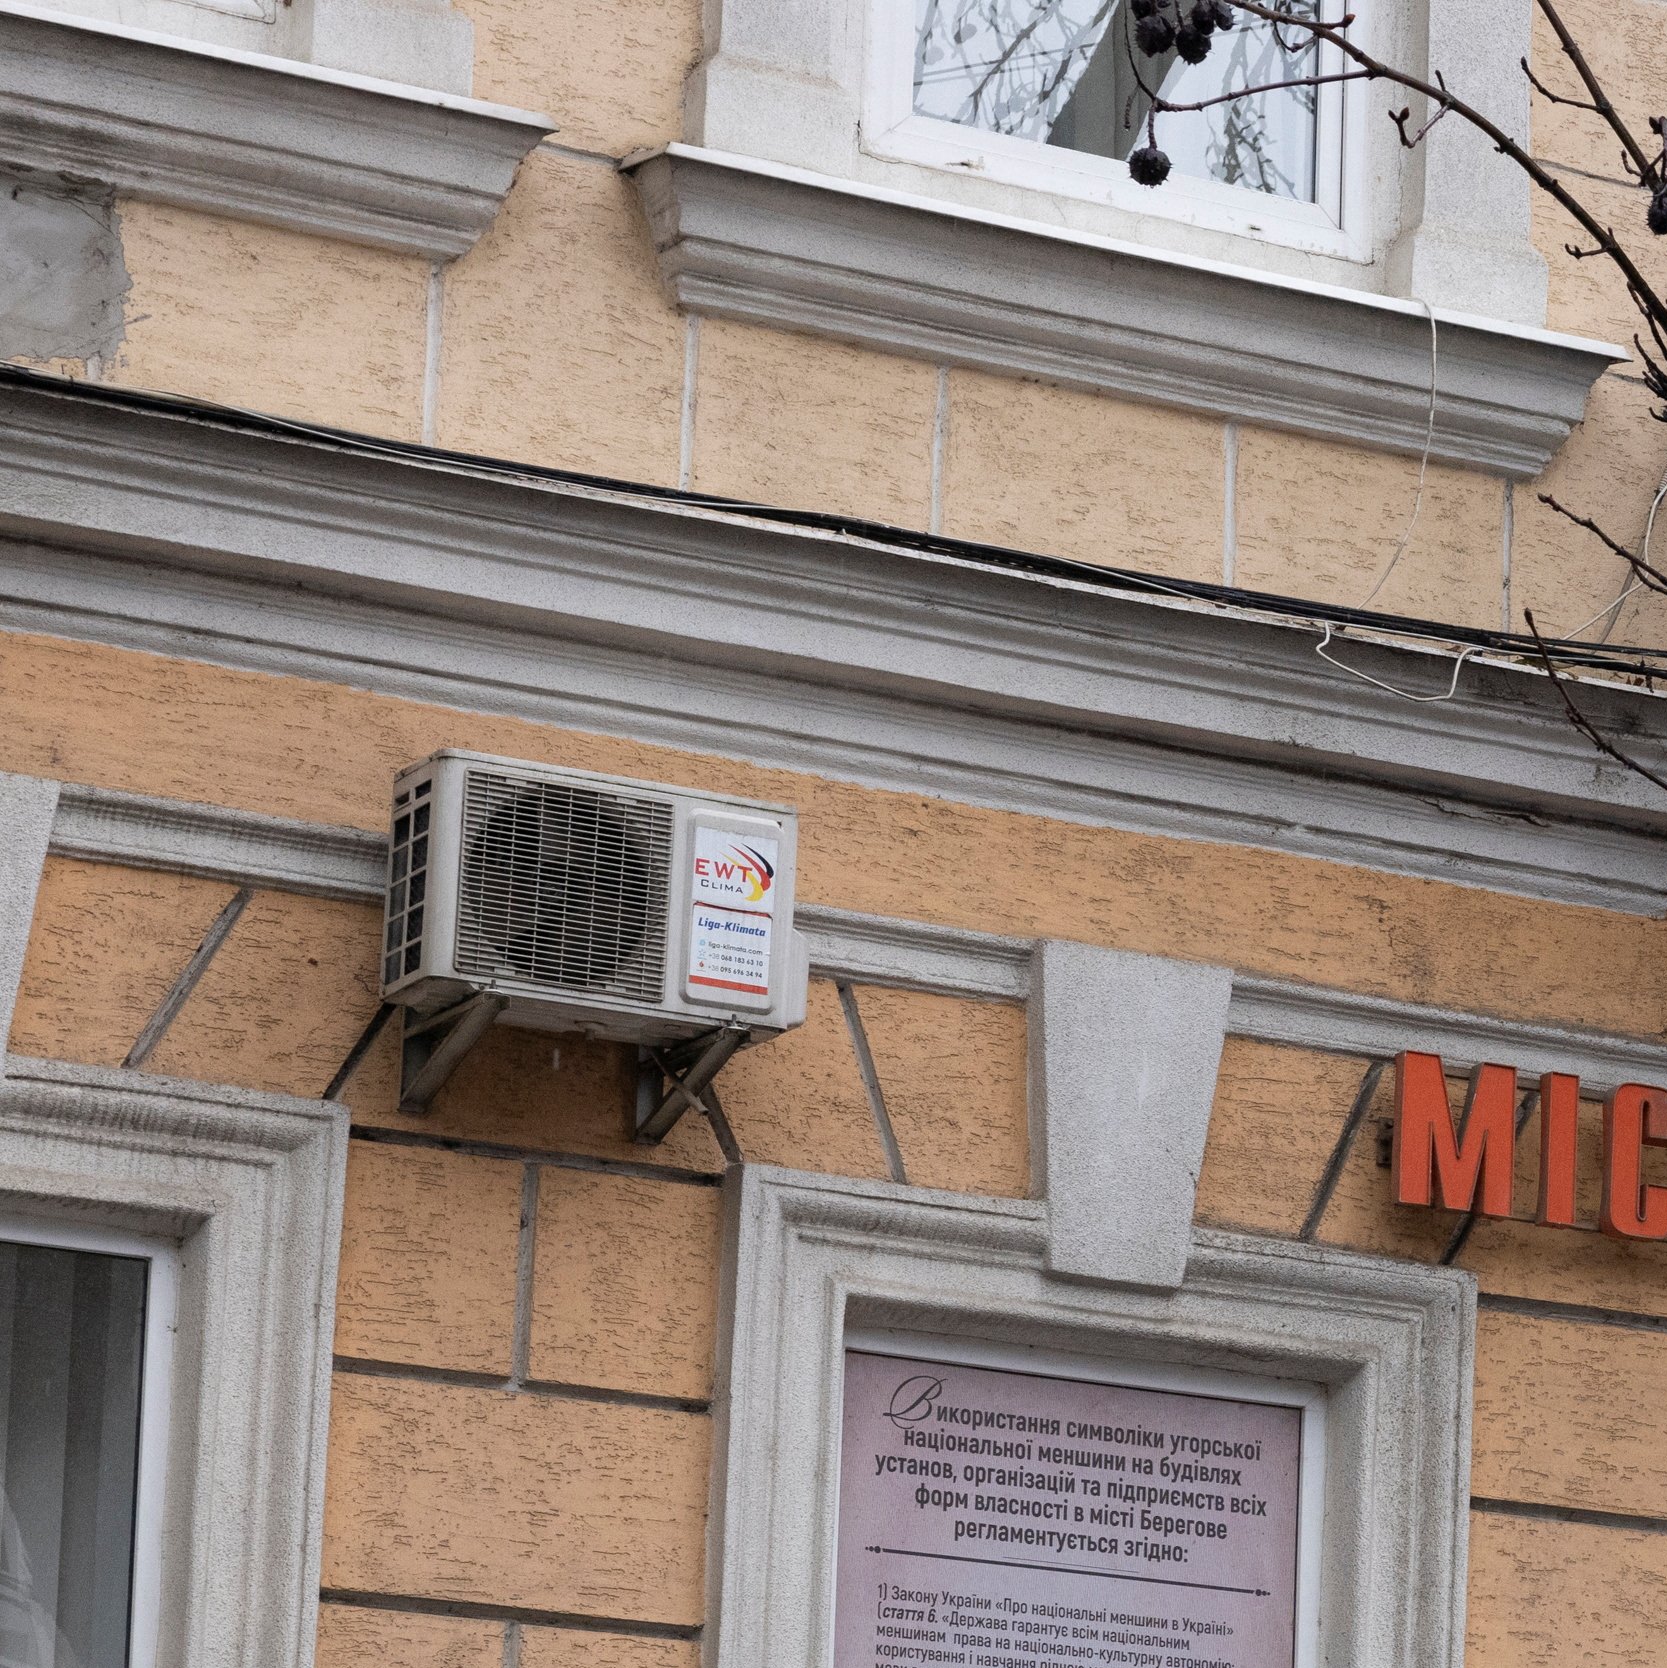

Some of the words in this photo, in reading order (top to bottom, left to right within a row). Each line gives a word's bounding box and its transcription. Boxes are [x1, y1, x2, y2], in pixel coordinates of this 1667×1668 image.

[695, 858, 752, 882] EWT
[701, 879, 743, 894] CLIMA
[698, 917, 766, 937] Liga-Klimata
[708, 941, 763, 956] liga-klimata.com
[734, 956, 745, 965] 183
[747, 958, 754, 966] 63
[756, 959, 764, 967] 10
[733, 968, 744, 976] 696
[746, 969, 754, 977] 34
[755, 971, 763, 979] 94
[883, 1375, 1060, 1438] Використання
[1067, 1422, 1164, 1448] символіки
[1170, 1435, 1262, 1460] угорської
[904, 1428, 1033, 1460] національної
[1038, 1446, 1126, 1471] меншини
[1132, 1458, 1153, 1475] на
[1160, 1456, 1241, 1486] будівлях
[875, 1455, 957, 1483] установ,
[964, 1465, 1075, 1494] організацій
[1081, 1479, 1100, 1496] та
[1108, 1478, 1224, 1511] підприємств
[1231, 1494, 1266, 1516] всіх
[915, 1483, 968, 1511] форм
[975, 1495, 1067, 1520] власності
[1074, 1506, 1084, 1522] в
[1090, 1508, 1133, 1528] місті
[1141, 1510, 1227, 1539] Берегове
[955, 1520, 1118, 1552] регламентується
[1124, 1540, 1188, 1562] згідно:
[878, 1583, 887, 1600] 1)
[892, 1586, 938, 1607] Закону
[942, 1591, 991, 1610] України
[996, 1598, 1027, 1616] «Про
[1032, 1603, 1106, 1622] національні
[1110, 1613, 1168, 1629] меншини
[1172, 1620, 1178, 1630] в
[1182, 1618, 1233, 1636] Україні»
[878, 1602, 924, 1621] (стаття
[928, 1609, 938, 1623] 6.
[942, 1611, 1007, 1630] «Держава
[1012, 1621, 1068, 1639] гарантує
[1072, 1625, 1098, 1640] всім
[1103, 1630, 1189, 1650] національним
